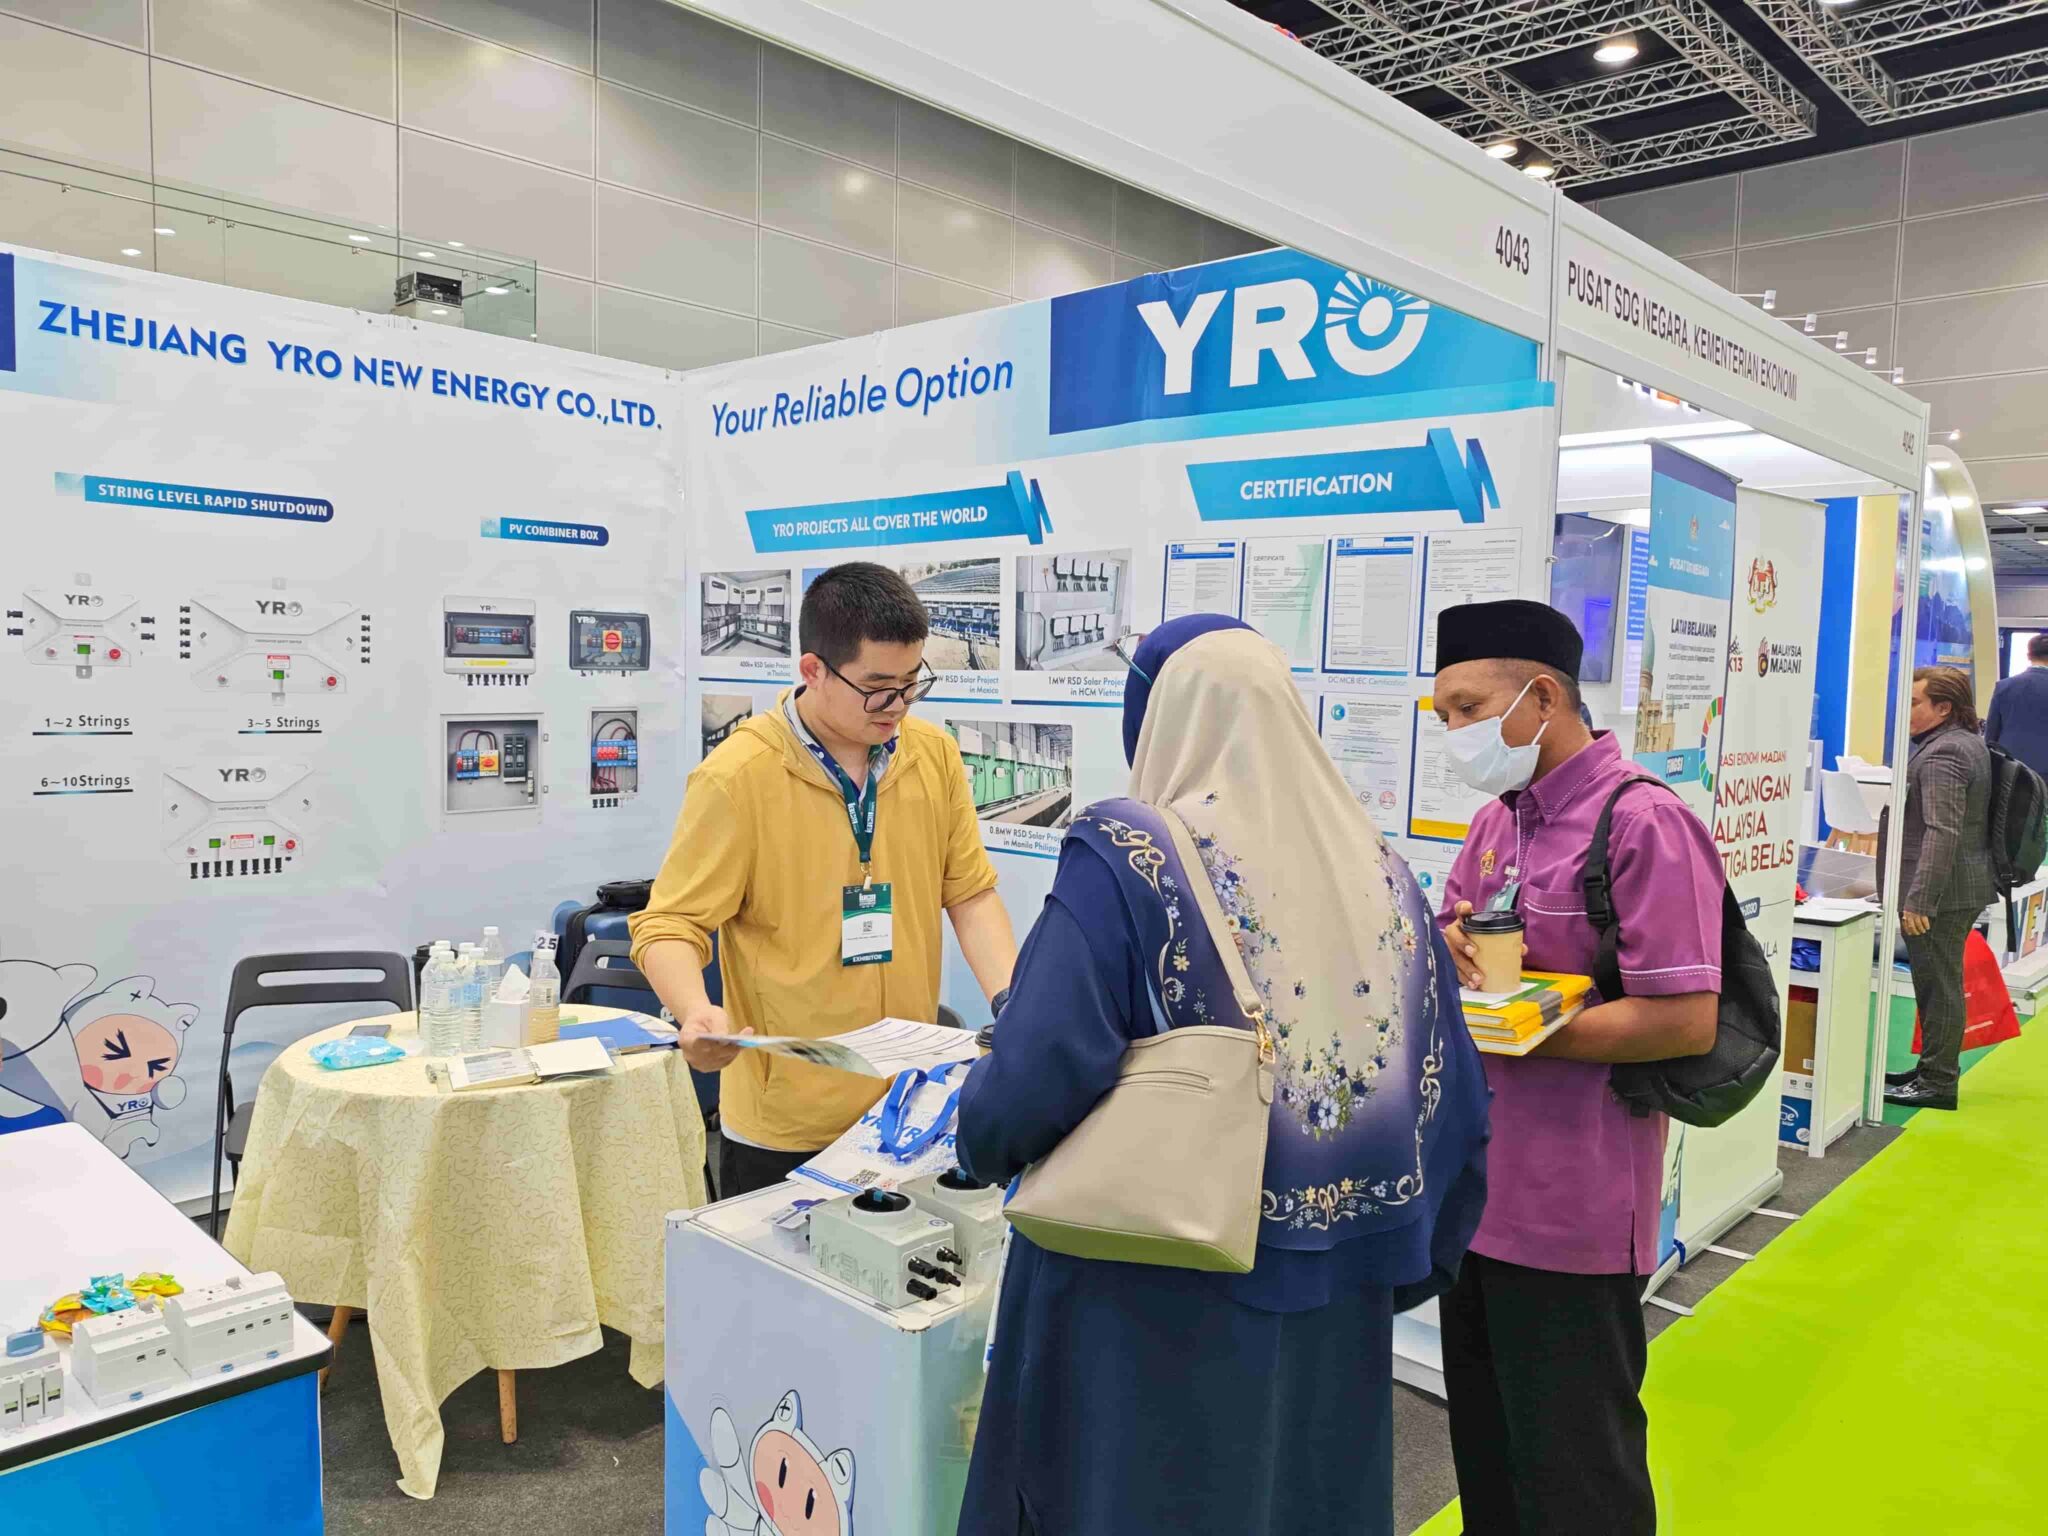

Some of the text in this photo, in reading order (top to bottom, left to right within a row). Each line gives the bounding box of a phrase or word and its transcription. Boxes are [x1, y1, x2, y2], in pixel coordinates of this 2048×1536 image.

[1495, 225, 1529, 275] 4043
[1136, 270, 1430, 396] YRO
[1568, 260, 1612, 312] PUSAT
[1614, 283, 1640, 326] SDG
[1643, 297, 1690, 358] NEGARA,
[1693, 323, 1759, 384] KEMENTERIAN
[1760, 358, 1798, 401] EKONOMI
[38, 299, 663, 430] ZHEJIANG YRO NEW ENERGY CO.,LTD.
[712, 357, 1014, 438] Your Reliable Option
[1239, 472, 1393, 501] CERTIFICATION
[98, 484, 328, 517] STRING LEVEL RAPID SHUTDOWN
[772, 506, 988, 538] YRO PROJECTS ALL COVER THE WORLD
[509, 523, 600, 540] PV COMBINER BOX
[64, 594, 104, 607] YRO
[255, 600, 304, 616] YRO
[1771, 643, 1802, 657] MALAYSIA
[1770, 657, 1802, 673] MADANI
[945, 675, 958, 684] RSD
[960, 675, 975, 684] Solar
[977, 676, 999, 686] Project
[1067, 676, 1081, 686] RSD
[1083, 676, 1101, 687] Solar
[1103, 677, 1125, 689] Projec
[976, 686, 999, 694] Mexico
[1079, 688, 1096, 697] HCM
[78, 715, 130, 729] Strings
[276, 716, 320, 731] Strings
[218, 768, 267, 783] YRO
[1013, 828, 1027, 838] RSD
[1028, 831, 1045, 840] Solar
[1750, 839, 1794, 873] BELAS
[116, 1098, 150, 1112] YRO
